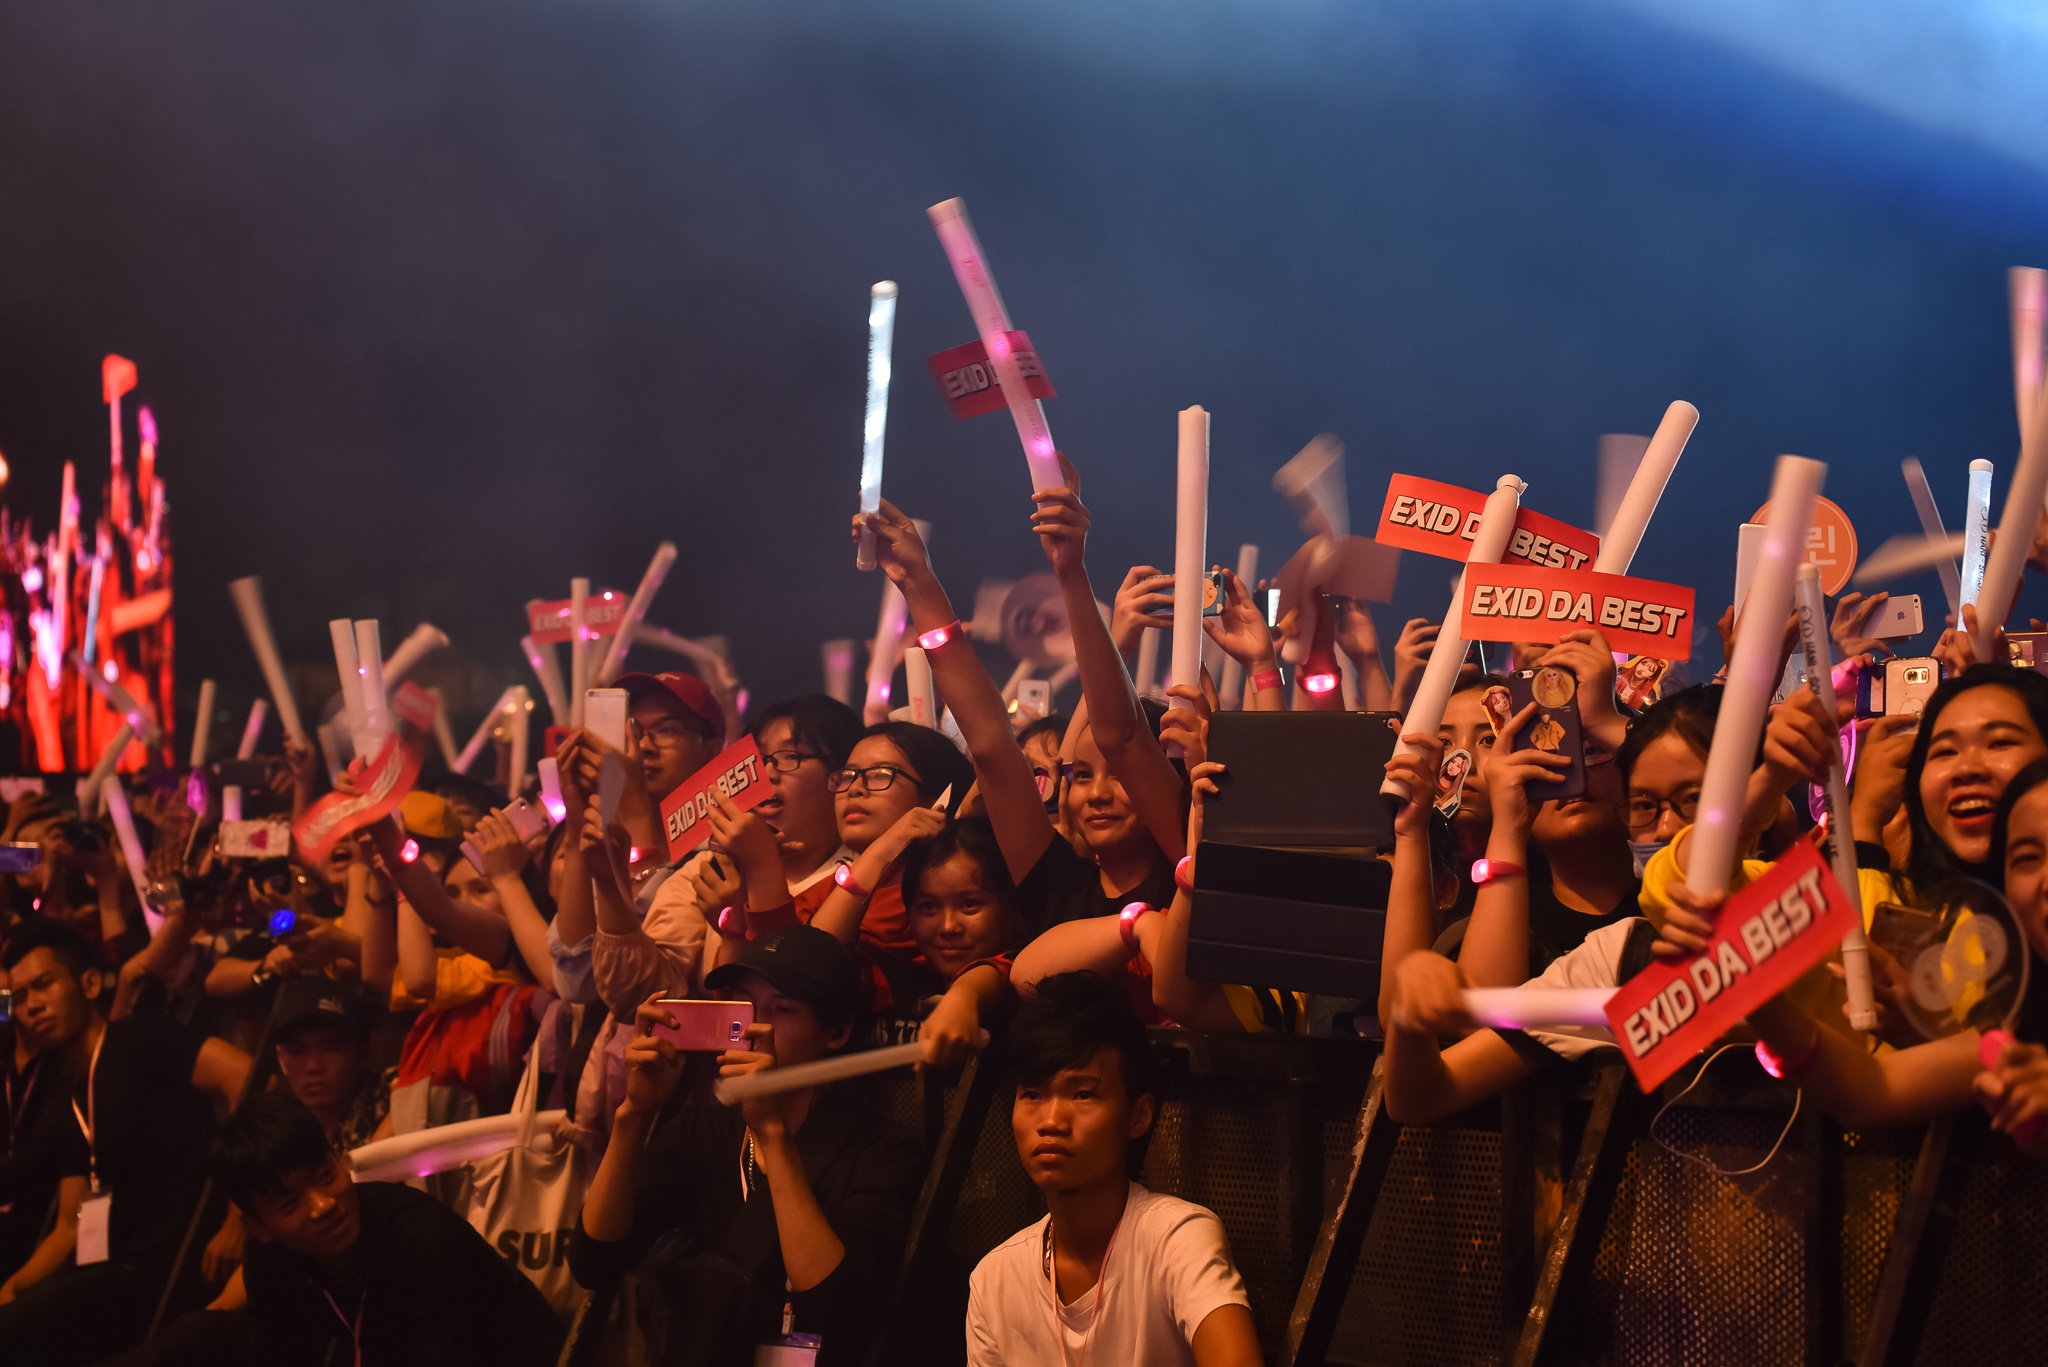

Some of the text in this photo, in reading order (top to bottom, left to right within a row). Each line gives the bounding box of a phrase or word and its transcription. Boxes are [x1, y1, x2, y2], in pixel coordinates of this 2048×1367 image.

[1389, 495, 1589, 570] EXID D BEST
[1803, 525, 1838, 566] 린
[1470, 584, 1687, 637] EXID DA BEST
[667, 800, 696, 841] EXID
[716, 754, 758, 798] BEST
[1623, 866, 1829, 1058] EXID DA BEST
